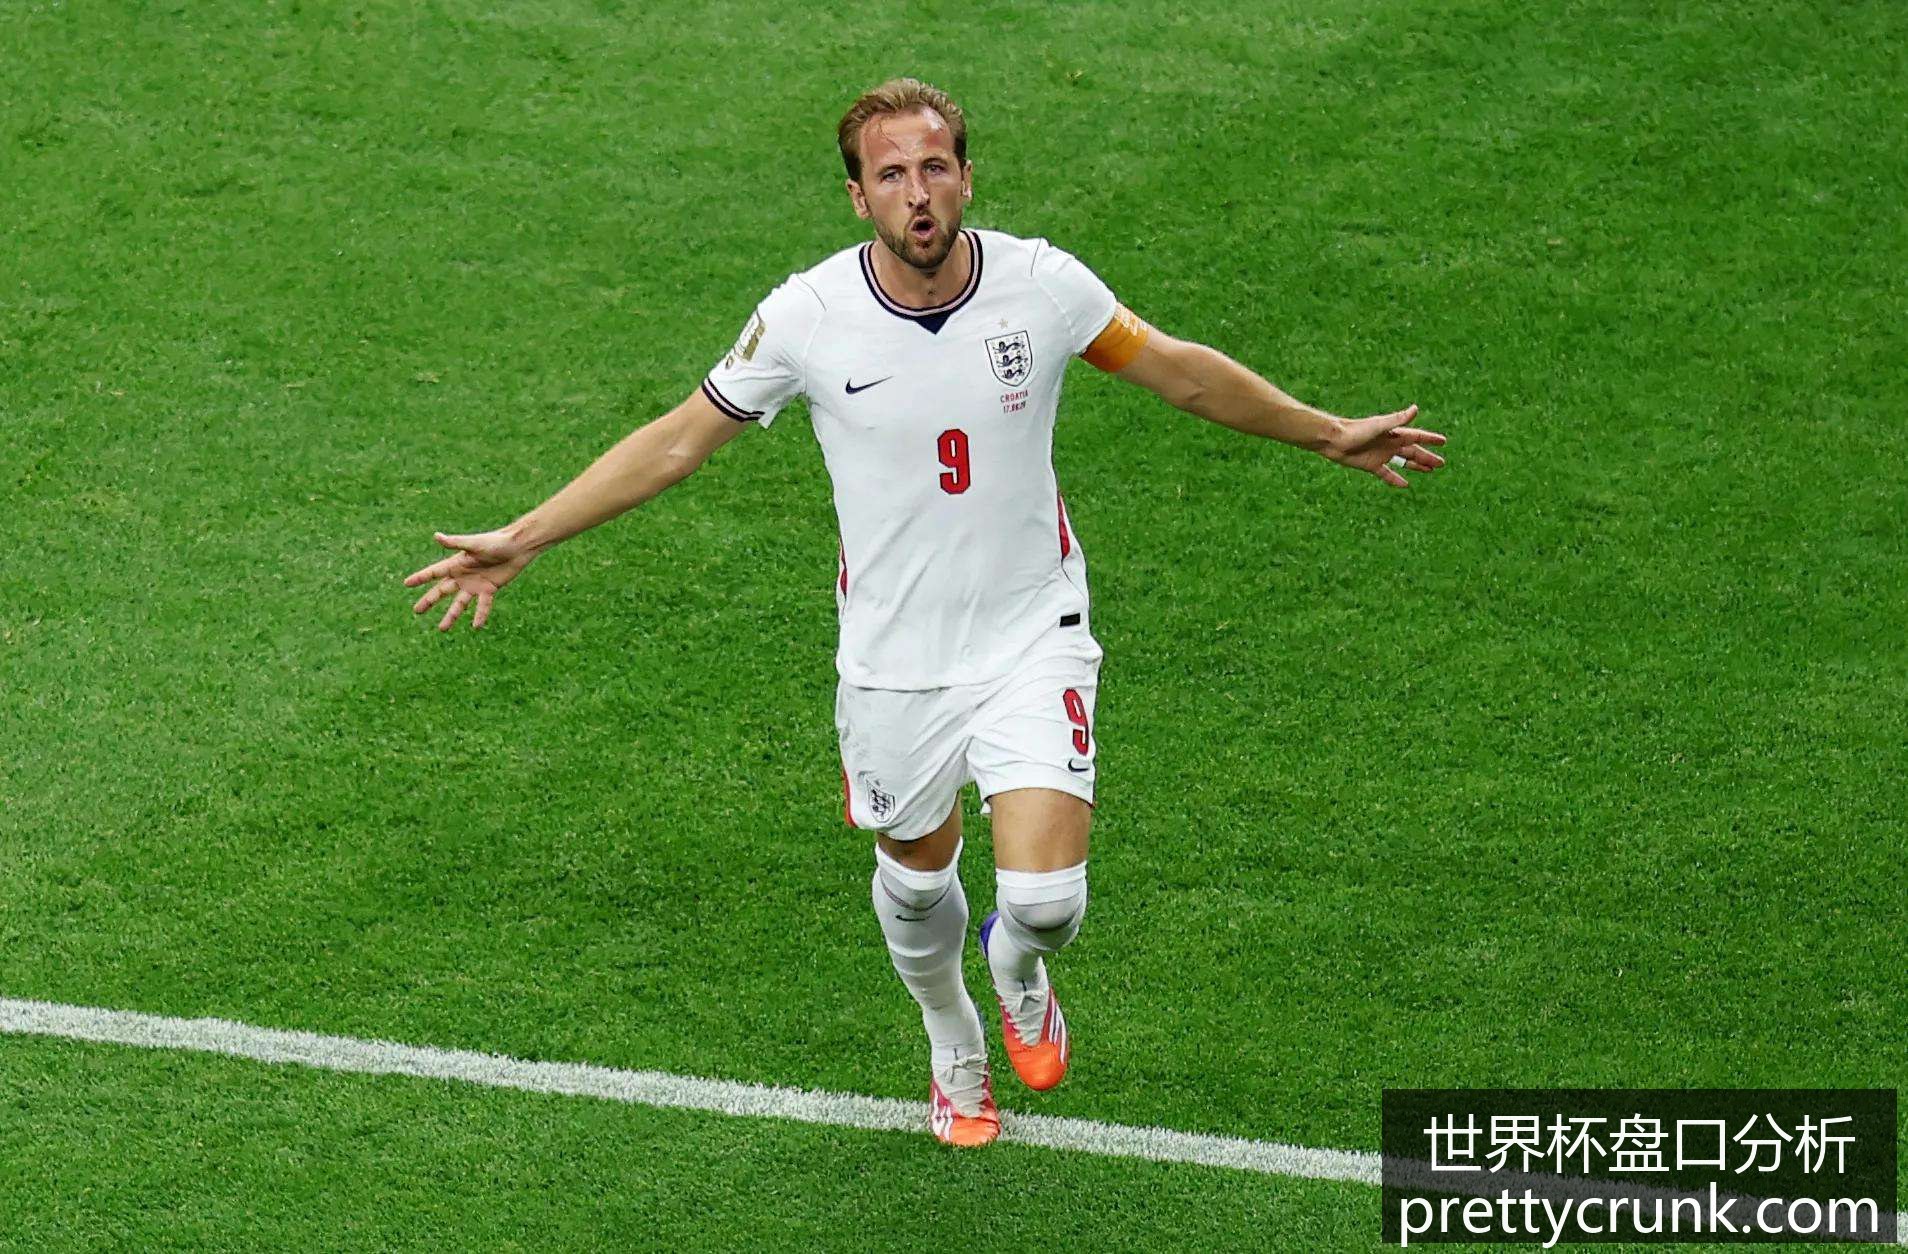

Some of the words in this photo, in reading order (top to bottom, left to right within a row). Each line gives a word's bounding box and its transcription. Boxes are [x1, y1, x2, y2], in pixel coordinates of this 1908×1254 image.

[1000, 389, 1028, 403] CROATIA
[937, 428, 971, 495] 9
[1063, 688, 1089, 756] 9
